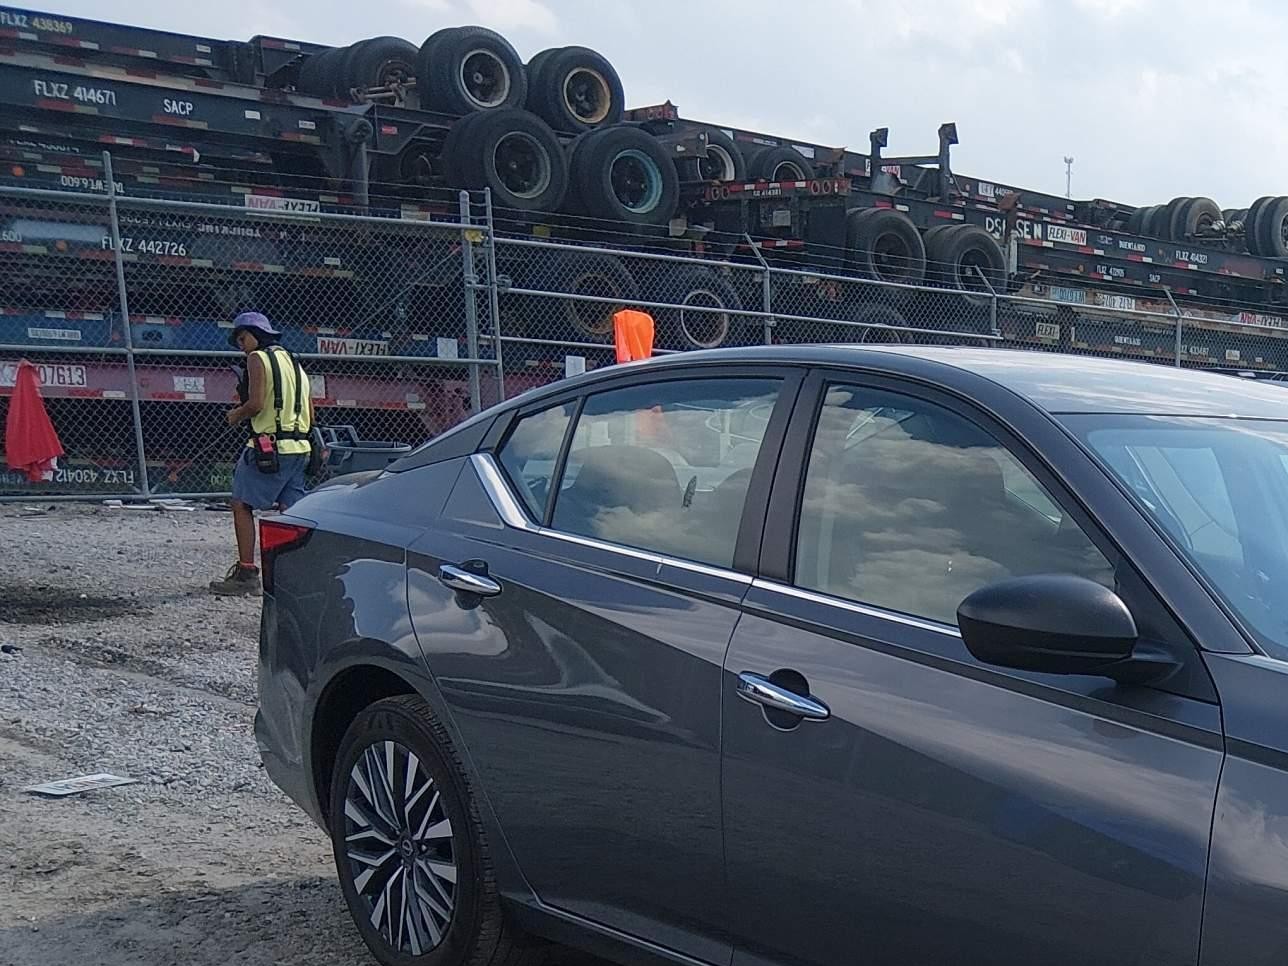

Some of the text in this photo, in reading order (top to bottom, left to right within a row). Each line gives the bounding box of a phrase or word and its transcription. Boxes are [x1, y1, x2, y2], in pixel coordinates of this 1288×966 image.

[33, 79, 117, 106] FLXZ 414671
[163, 99, 194, 115] SACP
[1048, 225, 1086, 244] FLEXI-VAN
[137, 240, 187, 256] 442726
[103, 470, 134, 484] FLXZ
